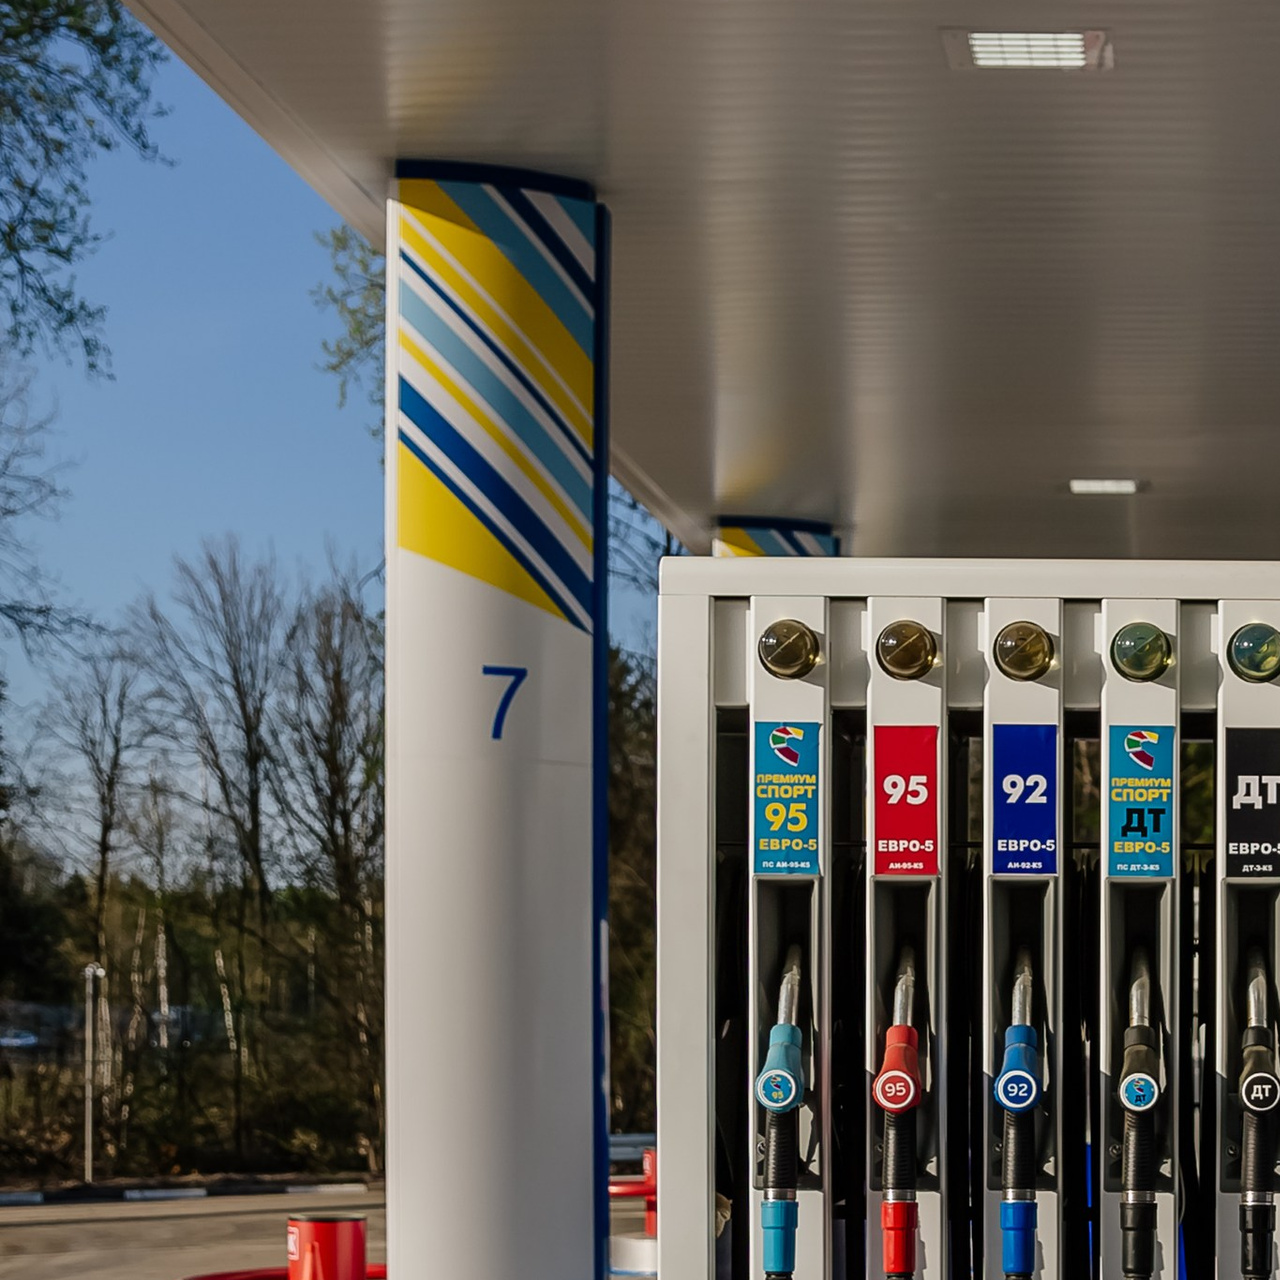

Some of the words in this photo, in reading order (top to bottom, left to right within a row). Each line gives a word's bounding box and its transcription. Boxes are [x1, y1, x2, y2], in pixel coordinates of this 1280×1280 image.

[482, 665, 528, 740] 7
[757, 774, 816, 783] ПРЕМИУМ
[1111, 777, 1171, 787] ПРЕМИУМ
[756, 785, 816, 798] СПОРТ
[883, 774, 928, 805] 95
[1002, 774, 1048, 804] 92
[1111, 788, 1171, 802] СПОРТ
[764, 802, 808, 832] 95
[1121, 808, 1166, 837] ДТ
[759, 839, 817, 850] ЕВРО-5
[878, 840, 934, 852] ЕВРО-5
[998, 839, 1055, 851] ЕВРО-5
[1113, 841, 1170, 853] ЕВРО-5
[1117, 863, 1128, 871] ПС
[772, 1091, 784, 1099] 95
[885, 1083, 906, 1097] 95
[1007, 1083, 1028, 1097] 92
[1250, 1084, 1272, 1099] ДТ
[1134, 1094, 1147, 1103] ДТ
